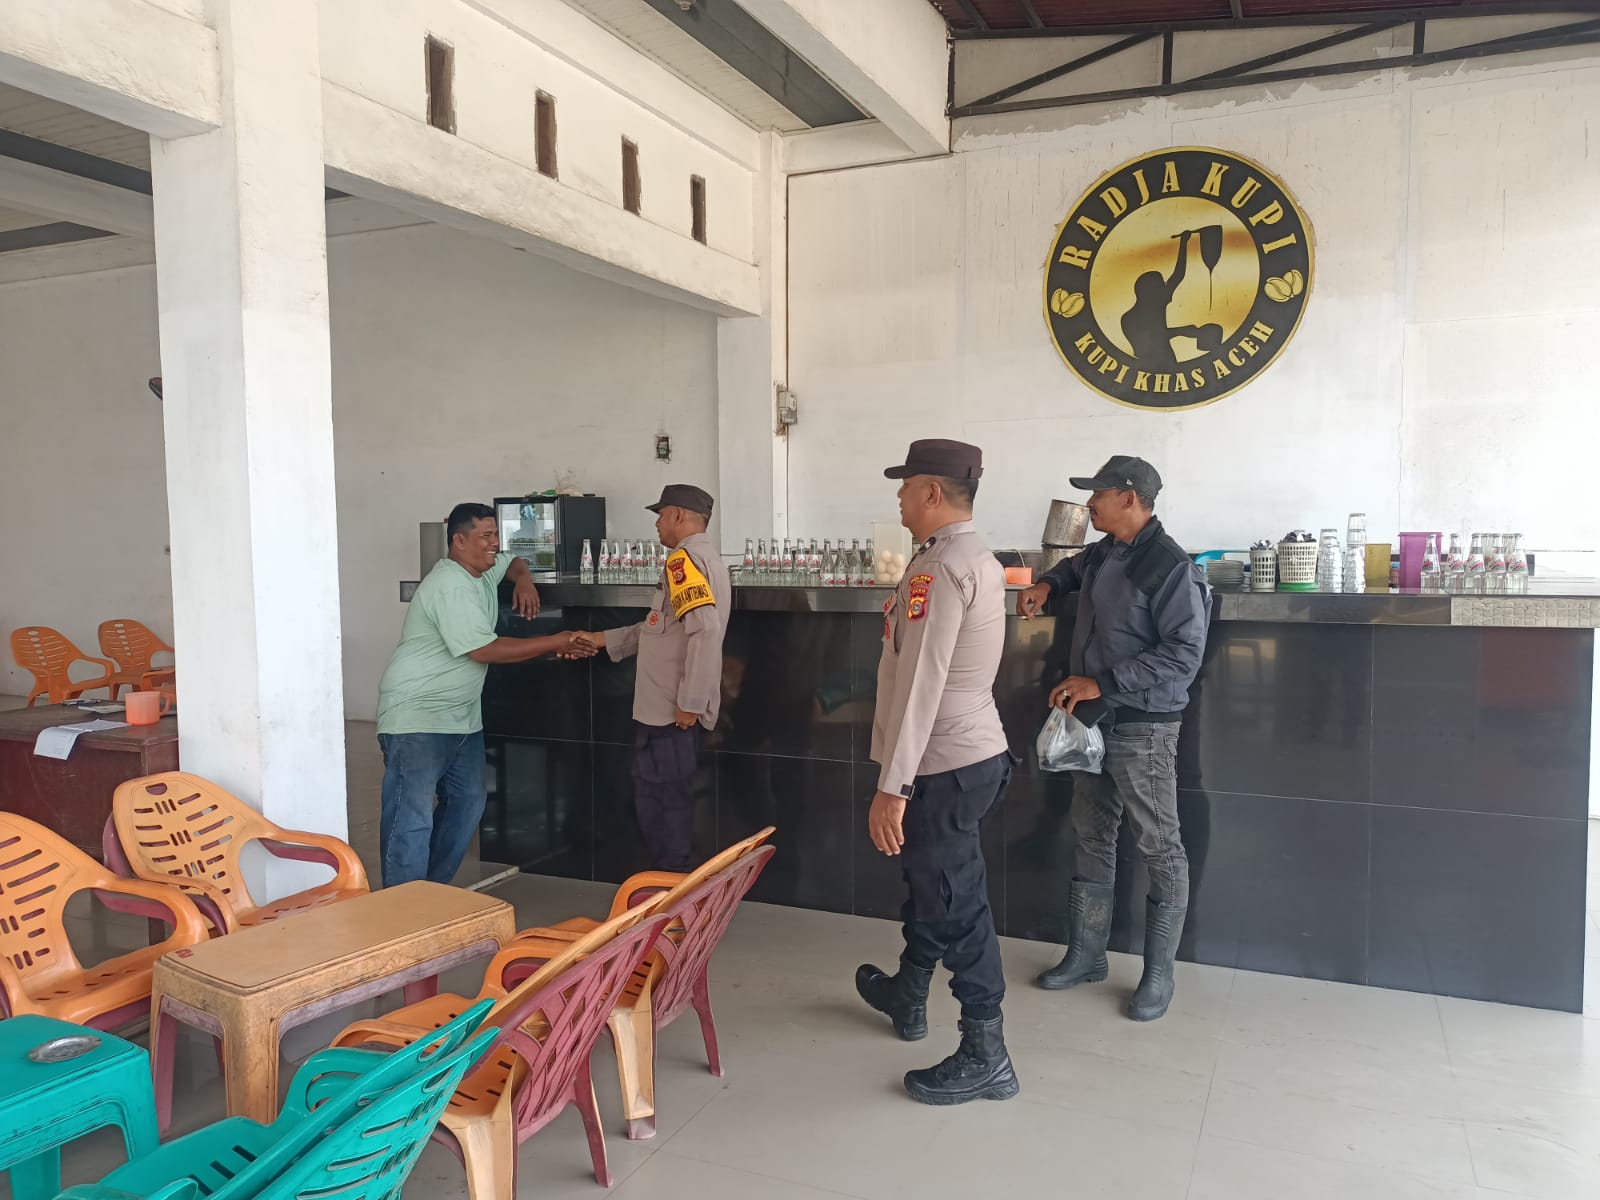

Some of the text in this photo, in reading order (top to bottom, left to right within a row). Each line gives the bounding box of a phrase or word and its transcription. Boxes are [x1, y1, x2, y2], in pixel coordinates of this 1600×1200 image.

[1058, 160, 1297, 269] RADJA KUPI
[1074, 320, 1275, 393] KUPI KHAS ACEH
